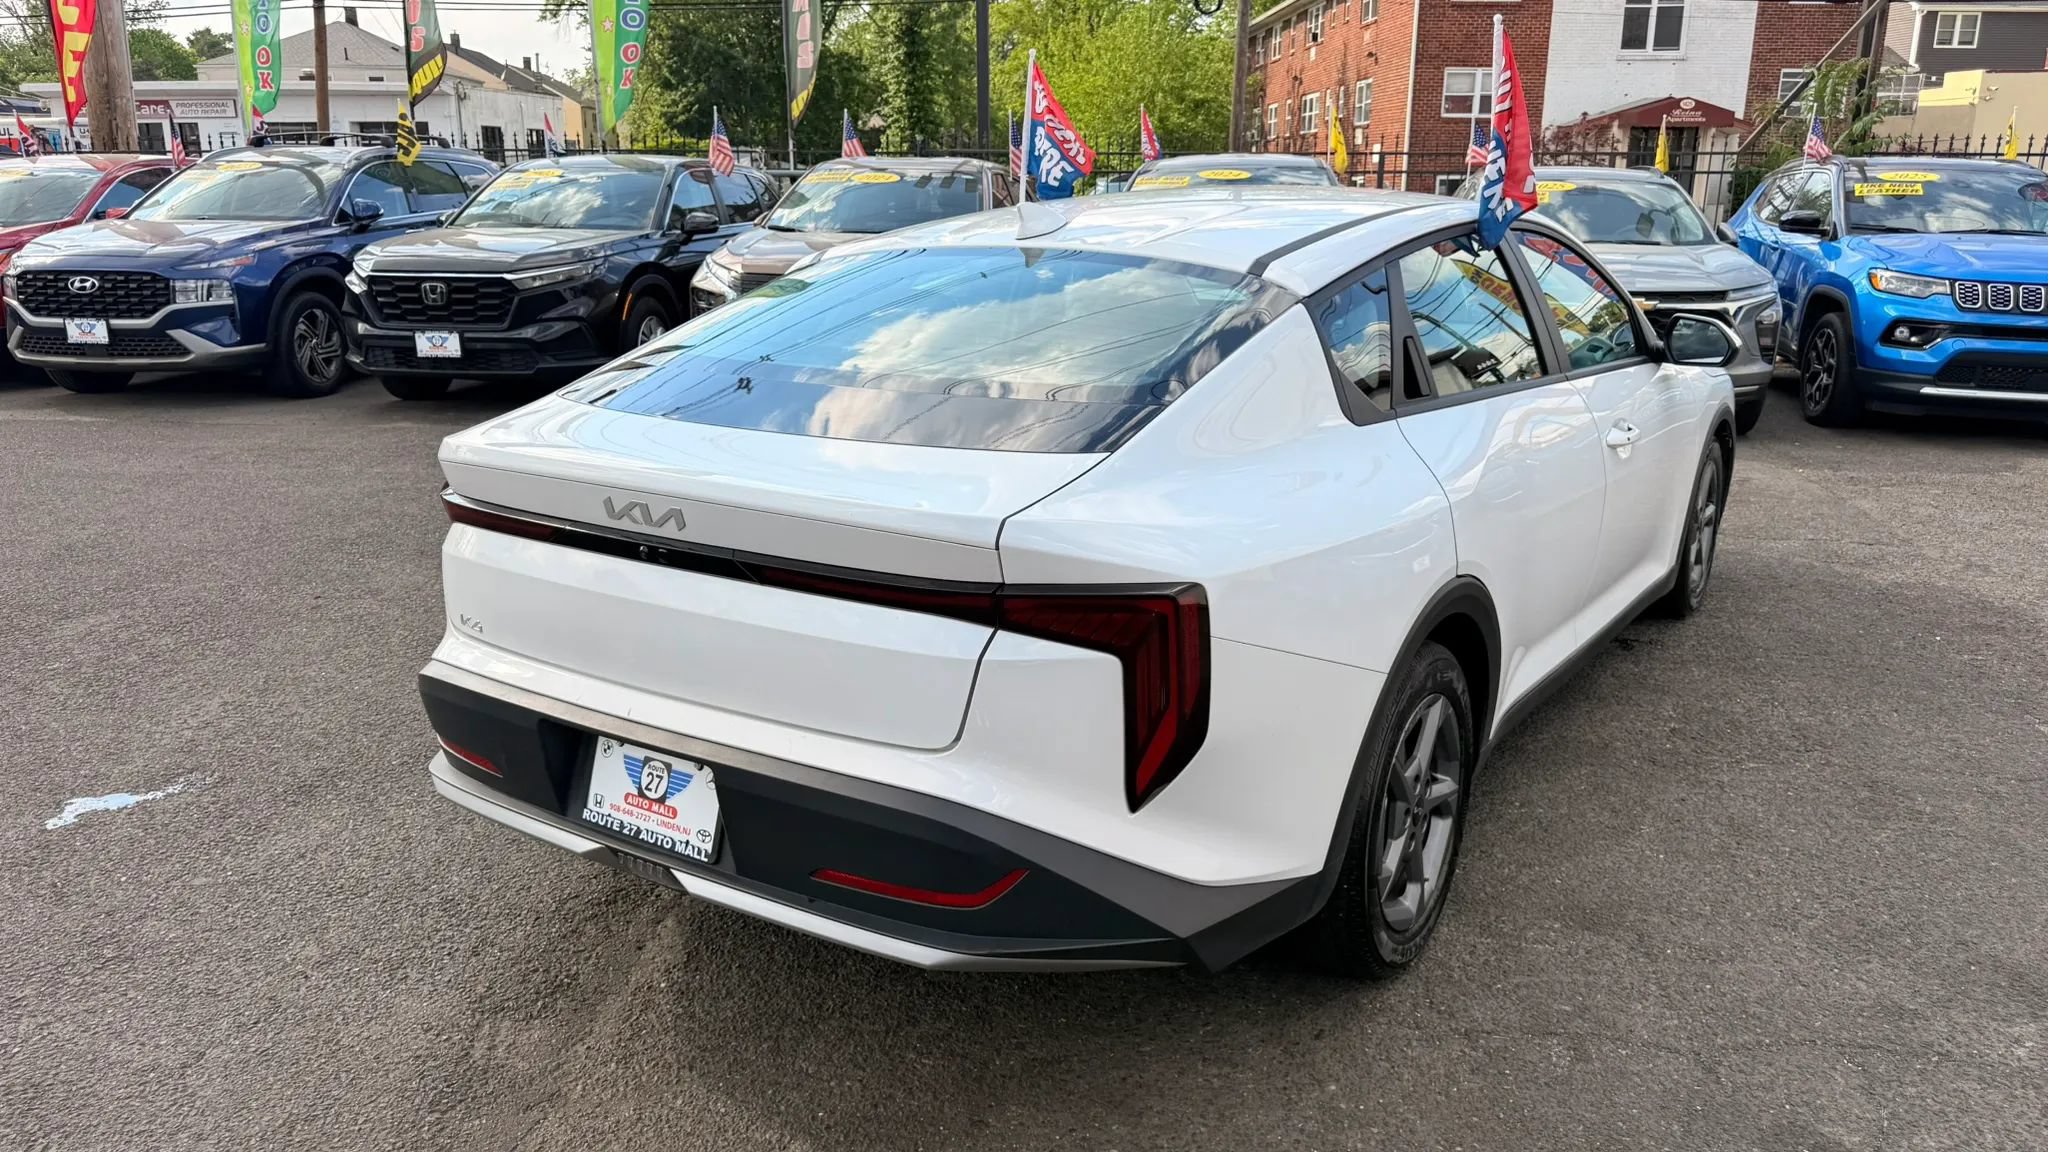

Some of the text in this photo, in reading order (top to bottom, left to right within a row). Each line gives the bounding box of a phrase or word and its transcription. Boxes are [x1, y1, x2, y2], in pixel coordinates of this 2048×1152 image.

[175, 101, 230, 109] PROFESSIONAL
[180, 108, 228, 116] AUTO REPAIR
[1858, 187, 1920, 195] LEATHER
[460, 613, 484, 634] K4
[647, 763, 666, 775] ROUTE
[644, 771, 665, 795] 27
[626, 795, 675, 819] AUTO MALL
[582, 807, 709, 863] ROUTE 27 AUTO MALL
